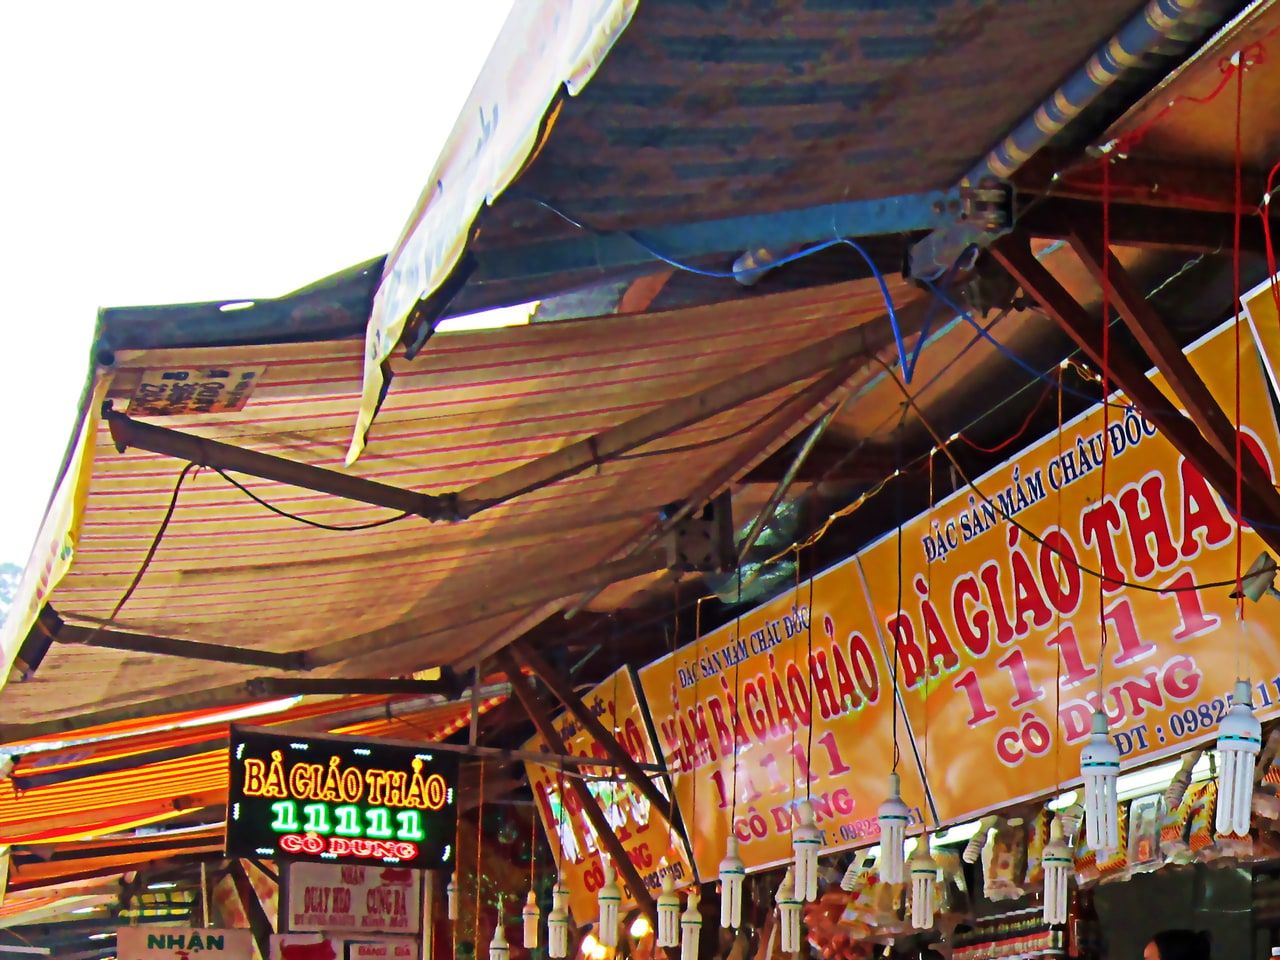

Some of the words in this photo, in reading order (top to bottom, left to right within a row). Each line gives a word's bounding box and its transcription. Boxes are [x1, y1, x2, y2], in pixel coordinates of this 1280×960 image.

[1047, 440, 1107, 491] CHÂU
[887, 574, 959, 691] BÀ
[953, 523, 1082, 655] GIÁO
[744, 652, 811, 745] GIÁO
[808, 615, 880, 720] HẢO
[996, 711, 1050, 764] CÔ
[1113, 724, 1147, 756] ĐT
[289, 756, 363, 803] GIÁO
[271, 801, 424, 841] 11111
[735, 806, 768, 843] CÔ
[329, 838, 419, 861] DUNG
